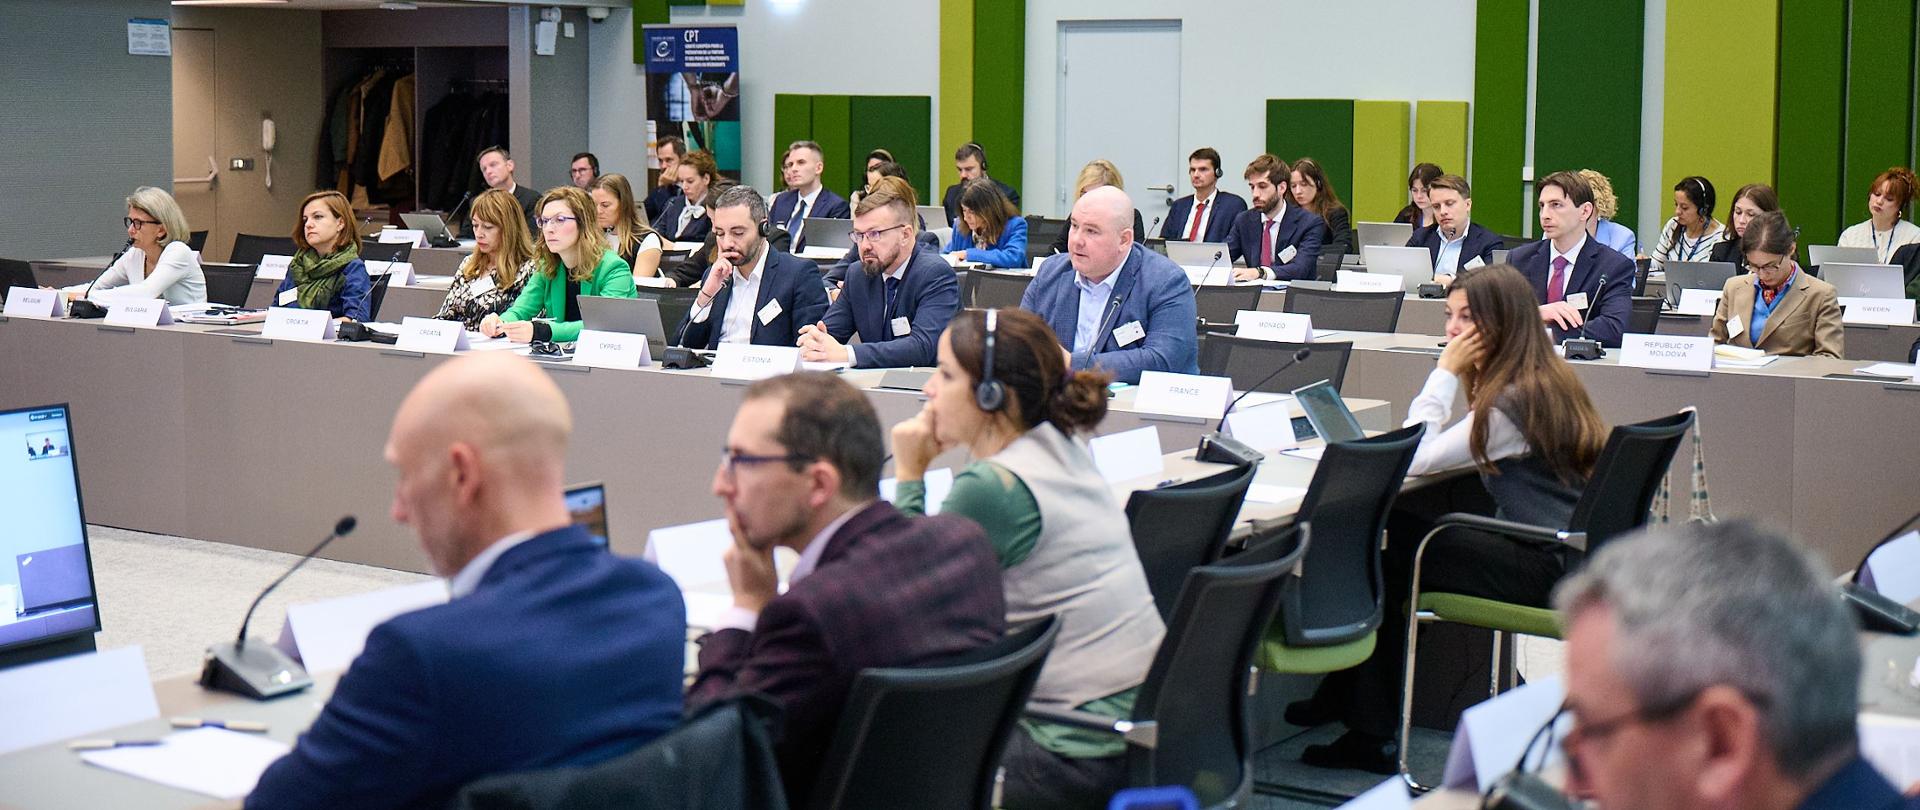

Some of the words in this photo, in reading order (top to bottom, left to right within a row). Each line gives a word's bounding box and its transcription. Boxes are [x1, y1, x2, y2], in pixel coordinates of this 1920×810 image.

[684, 30, 699, 42] CPT
[1259, 321, 1286, 329] MONACO
[599, 343, 622, 351] CYPRUS
[1644, 341, 1682, 349] REPUBLIC
[1649, 350, 1687, 358] MOLDOVA
[742, 355, 772, 364] ESTONIA
[1169, 386, 1200, 396] FRANCE
